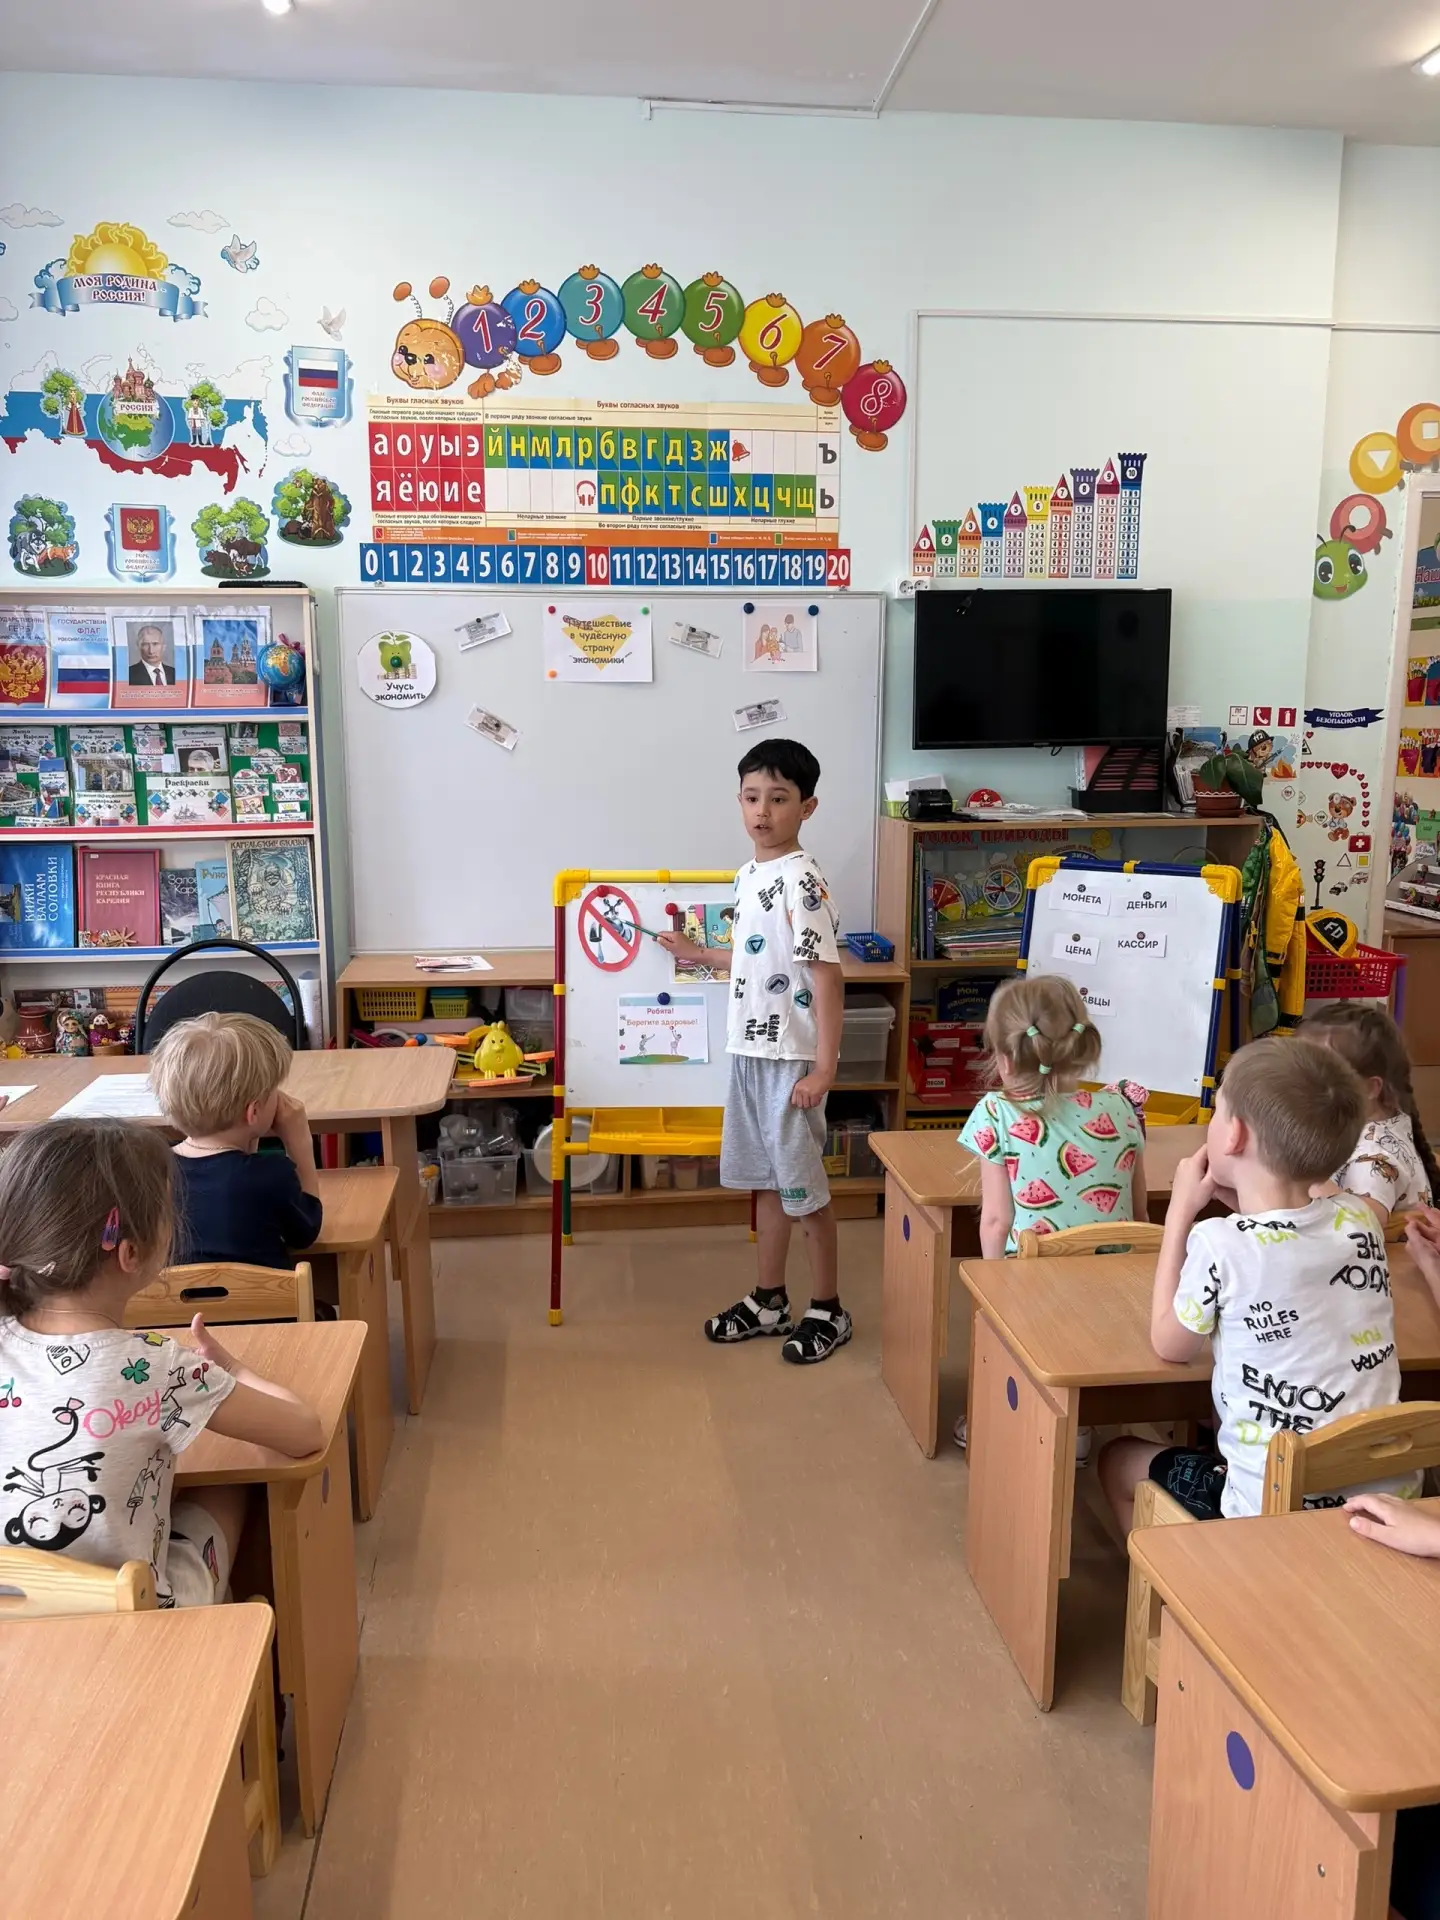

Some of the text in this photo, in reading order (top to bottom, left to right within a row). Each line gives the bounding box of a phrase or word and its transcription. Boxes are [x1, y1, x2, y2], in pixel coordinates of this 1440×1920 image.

[74, 276, 158, 291] МОЯ РОДИНА
[92, 290, 145, 301] РОССИЯ!
[579, 284, 604, 325] 3
[638, 283, 667, 323] 4
[519, 299, 547, 340] 2
[699, 291, 728, 331] 5
[474, 310, 492, 352] 1
[759, 313, 788, 350] 6
[813, 334, 848, 369] 7
[386, 396, 408, 405] Буквы
[861, 379, 892, 416] 8
[374, 434, 388, 455] а
[397, 435, 411, 455] о
[420, 435, 434, 464] у
[441, 436, 460, 456] ы
[467, 436, 480, 456] э
[488, 428, 503, 456] й
[511, 438, 526, 456] н
[532, 437, 550, 456] м
[556, 437, 571, 457] л
[578, 438, 592, 464] р
[600, 431, 614, 459] б
[623, 439, 636, 459] в
[647, 439, 657, 459] г
[667, 440, 683, 465] д
[691, 440, 702, 461] з
[710, 441, 727, 460] ж
[376, 481, 390, 502] я
[399, 473, 413, 502] ё
[419, 482, 438, 502] ю
[444, 482, 458, 502] и
[468, 482, 481, 502] е
[601, 484, 614, 504] п
[622, 477, 639, 512] ф
[646, 486, 658, 505] к
[669, 486, 680, 505] т
[691, 486, 702, 506] с
[710, 487, 727, 506] ш
[734, 487, 747, 506] х
[755, 488, 769, 512] ц
[777, 488, 790, 507] ч
[797, 488, 814, 513] щ
[366, 550, 849, 580] 0 1 2 3 4 5 6 7 8 9 10 11 12 13 14 15 16 17 18 19 20
[580, 632, 626, 642] чудесную
[583, 644, 614, 654] страну
[386, 682, 414, 692] Учусь
[980, 829, 1069, 843] ПРИРОДЫ
[168, 874, 197, 885] Запо
[201, 868, 227, 879] Руно
[36, 873, 46, 921] ВАЛААМ
[48, 857, 57, 922] СОЛОВКИ
[1062, 893, 1102, 904] МОНЕТА
[25, 883, 34, 922] КИЖИ
[1127, 901, 1167, 910] ДЕНЬГИ
[1324, 921, 1344, 939] FD
[1065, 945, 1092, 956] ЦЕНА
[1118, 940, 1159, 949] КАССИР
[1082, 996, 1110, 1006] АВЦЫ
[661, 1019, 698, 1027] здоровье!
[1256, 1230, 1299, 1245] FUN
[1250, 1301, 1272, 1314] NO
[1244, 1309, 1300, 1330] RULES
[1256, 1328, 1293, 1344] HERE
[1242, 1363, 1346, 1413] ENJOY
[83, 1390, 162, 1439] Okay
[1249, 1400, 1314, 1436] THE
